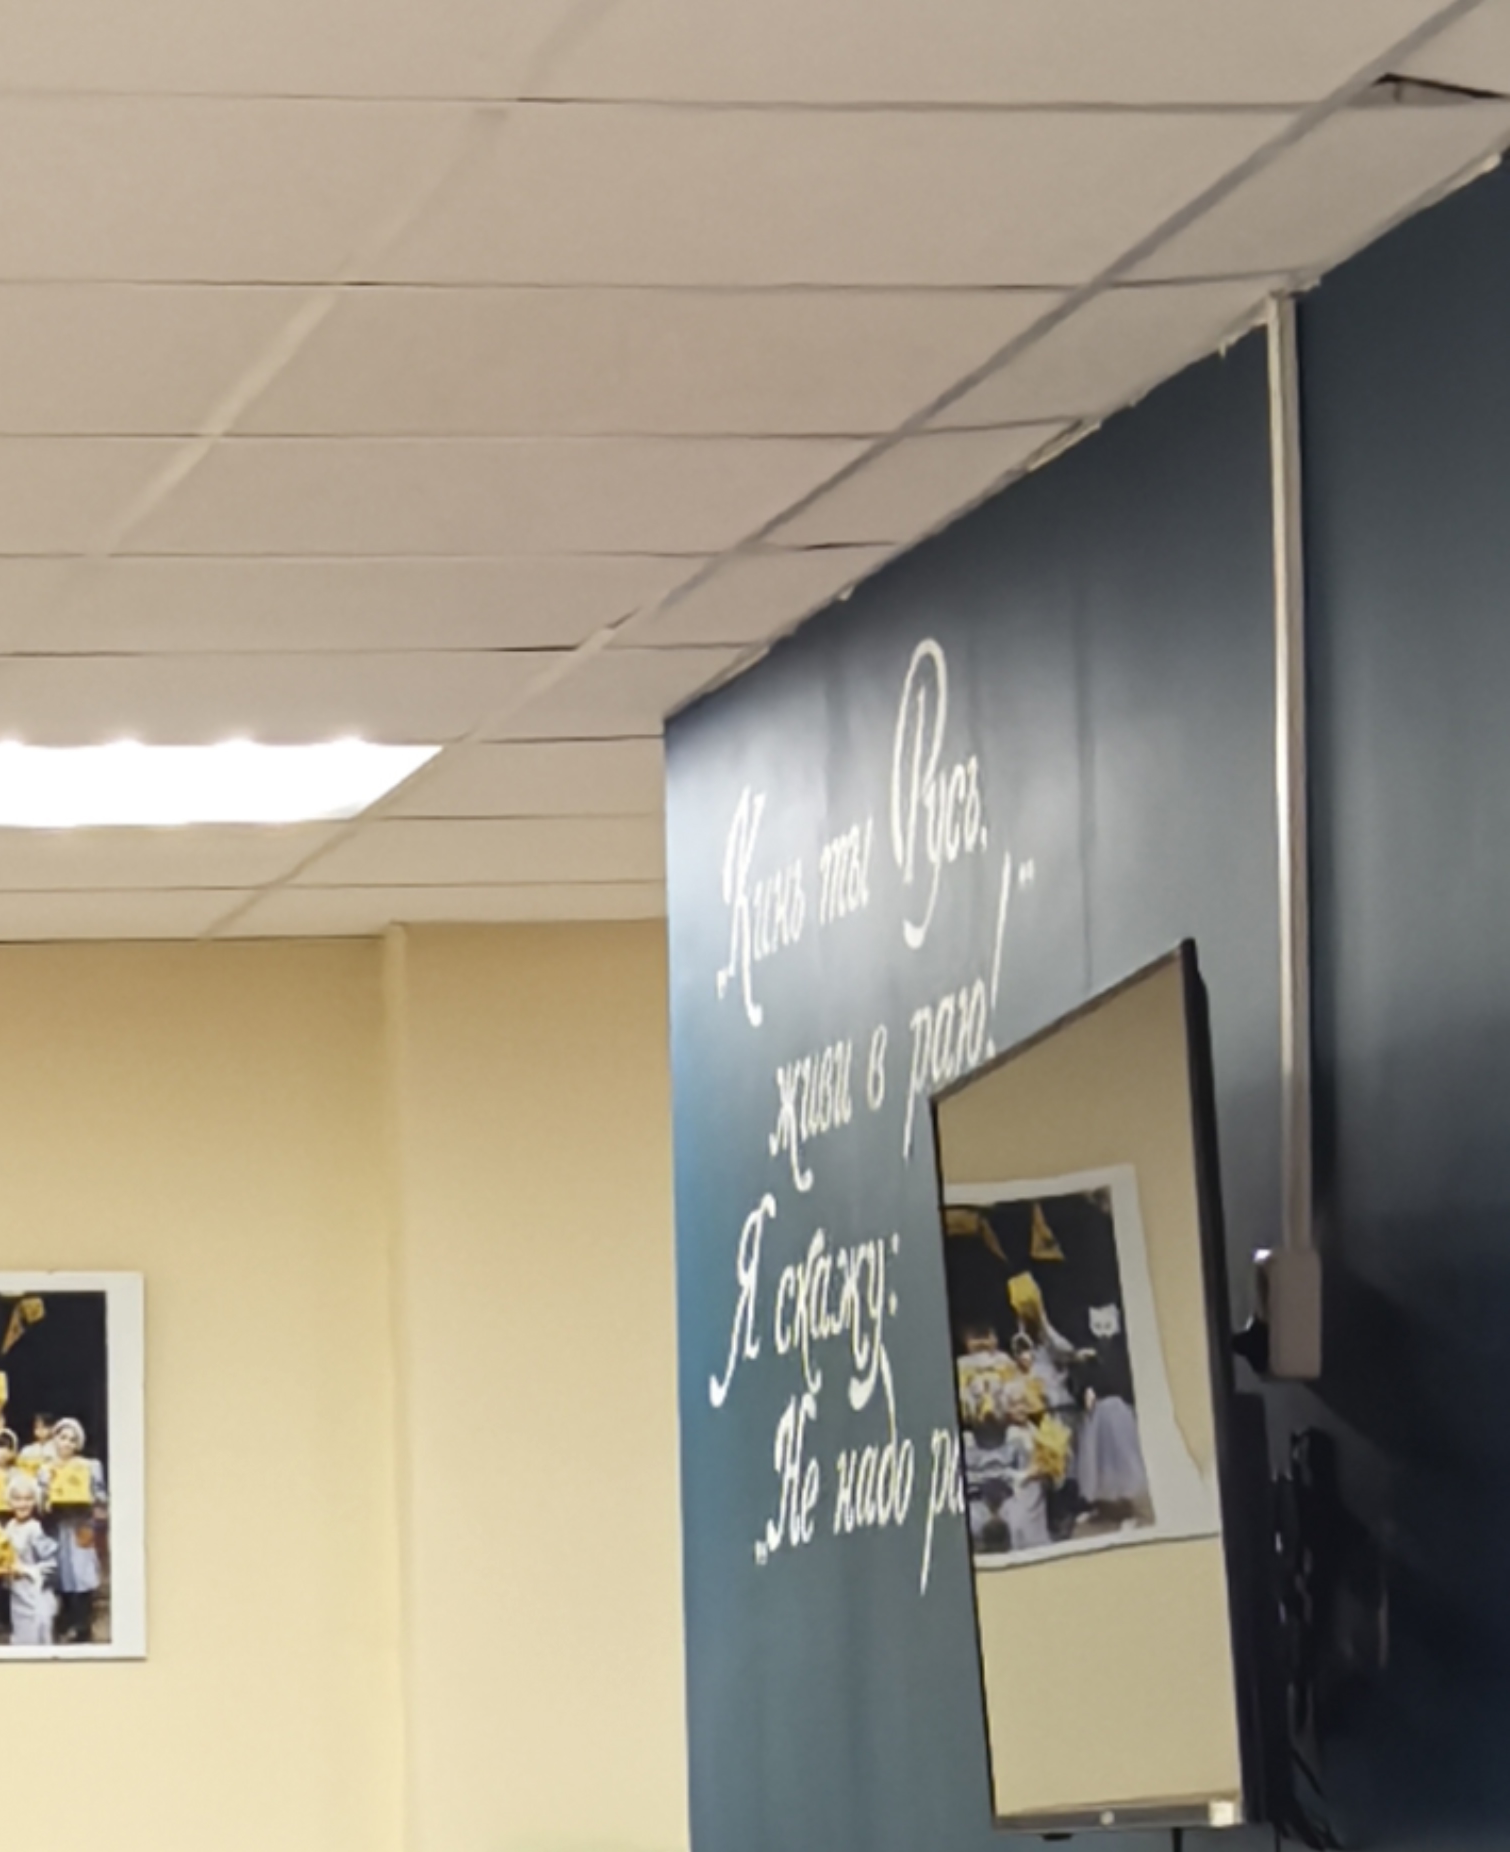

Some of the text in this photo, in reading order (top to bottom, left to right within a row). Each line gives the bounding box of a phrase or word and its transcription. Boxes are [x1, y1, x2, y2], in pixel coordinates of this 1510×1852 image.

[769, 1038, 852, 1192] живи
[867, 1023, 887, 1110] в
[710, 1193, 900, 1410] Я скажу:
